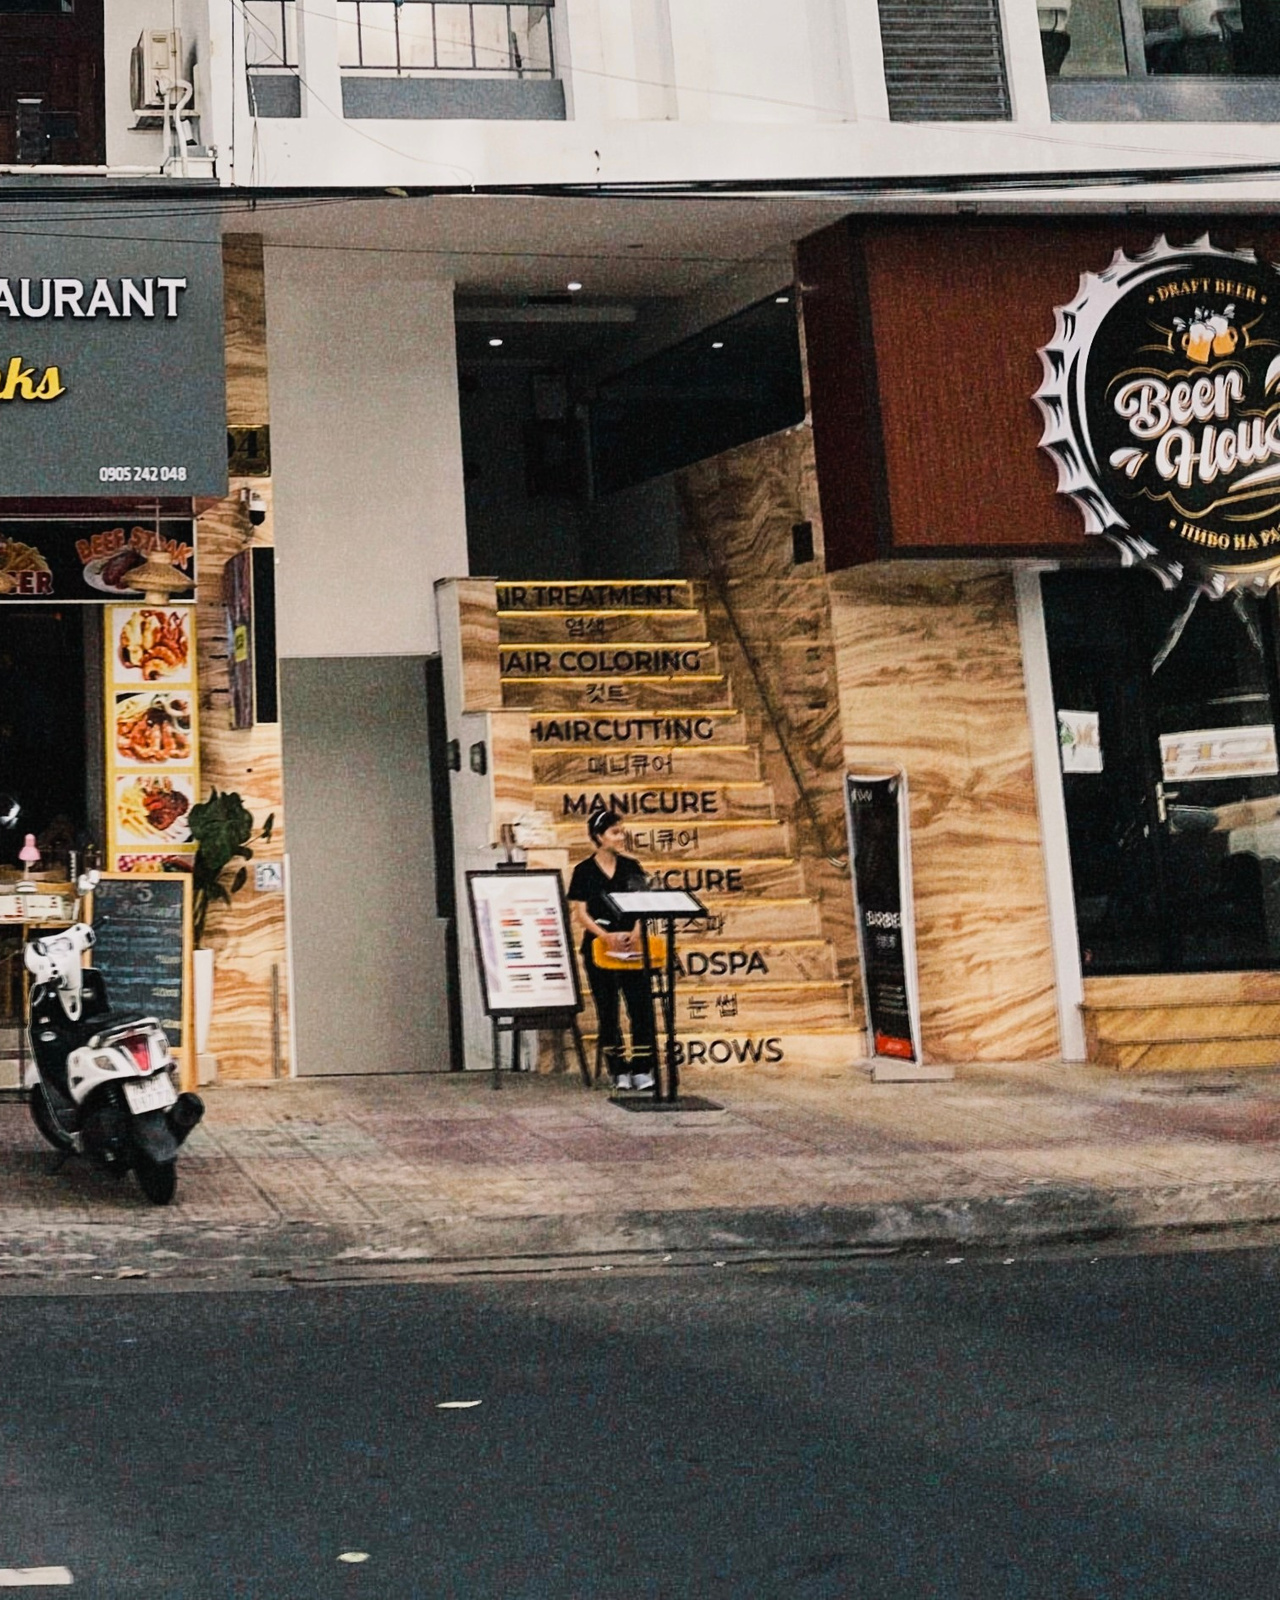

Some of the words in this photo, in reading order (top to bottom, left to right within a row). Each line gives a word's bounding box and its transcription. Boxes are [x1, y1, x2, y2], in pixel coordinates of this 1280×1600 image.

[1157, 278, 1210, 302] DRAFT
[1215, 279, 1256, 302] BEER
[1114, 369, 1246, 441] Beer
[99, 466, 132, 482] 0905
[133, 466, 158, 482] 242
[160, 466, 187, 482] 048
[75, 528, 124, 564] BEEF
[1260, 523, 1280, 546] РА
[534, 586, 676, 606] TREATMENT
[559, 651, 701, 672] COLORING
[588, 754, 673, 775] 매니큐어
[563, 791, 718, 816] MANICURE
